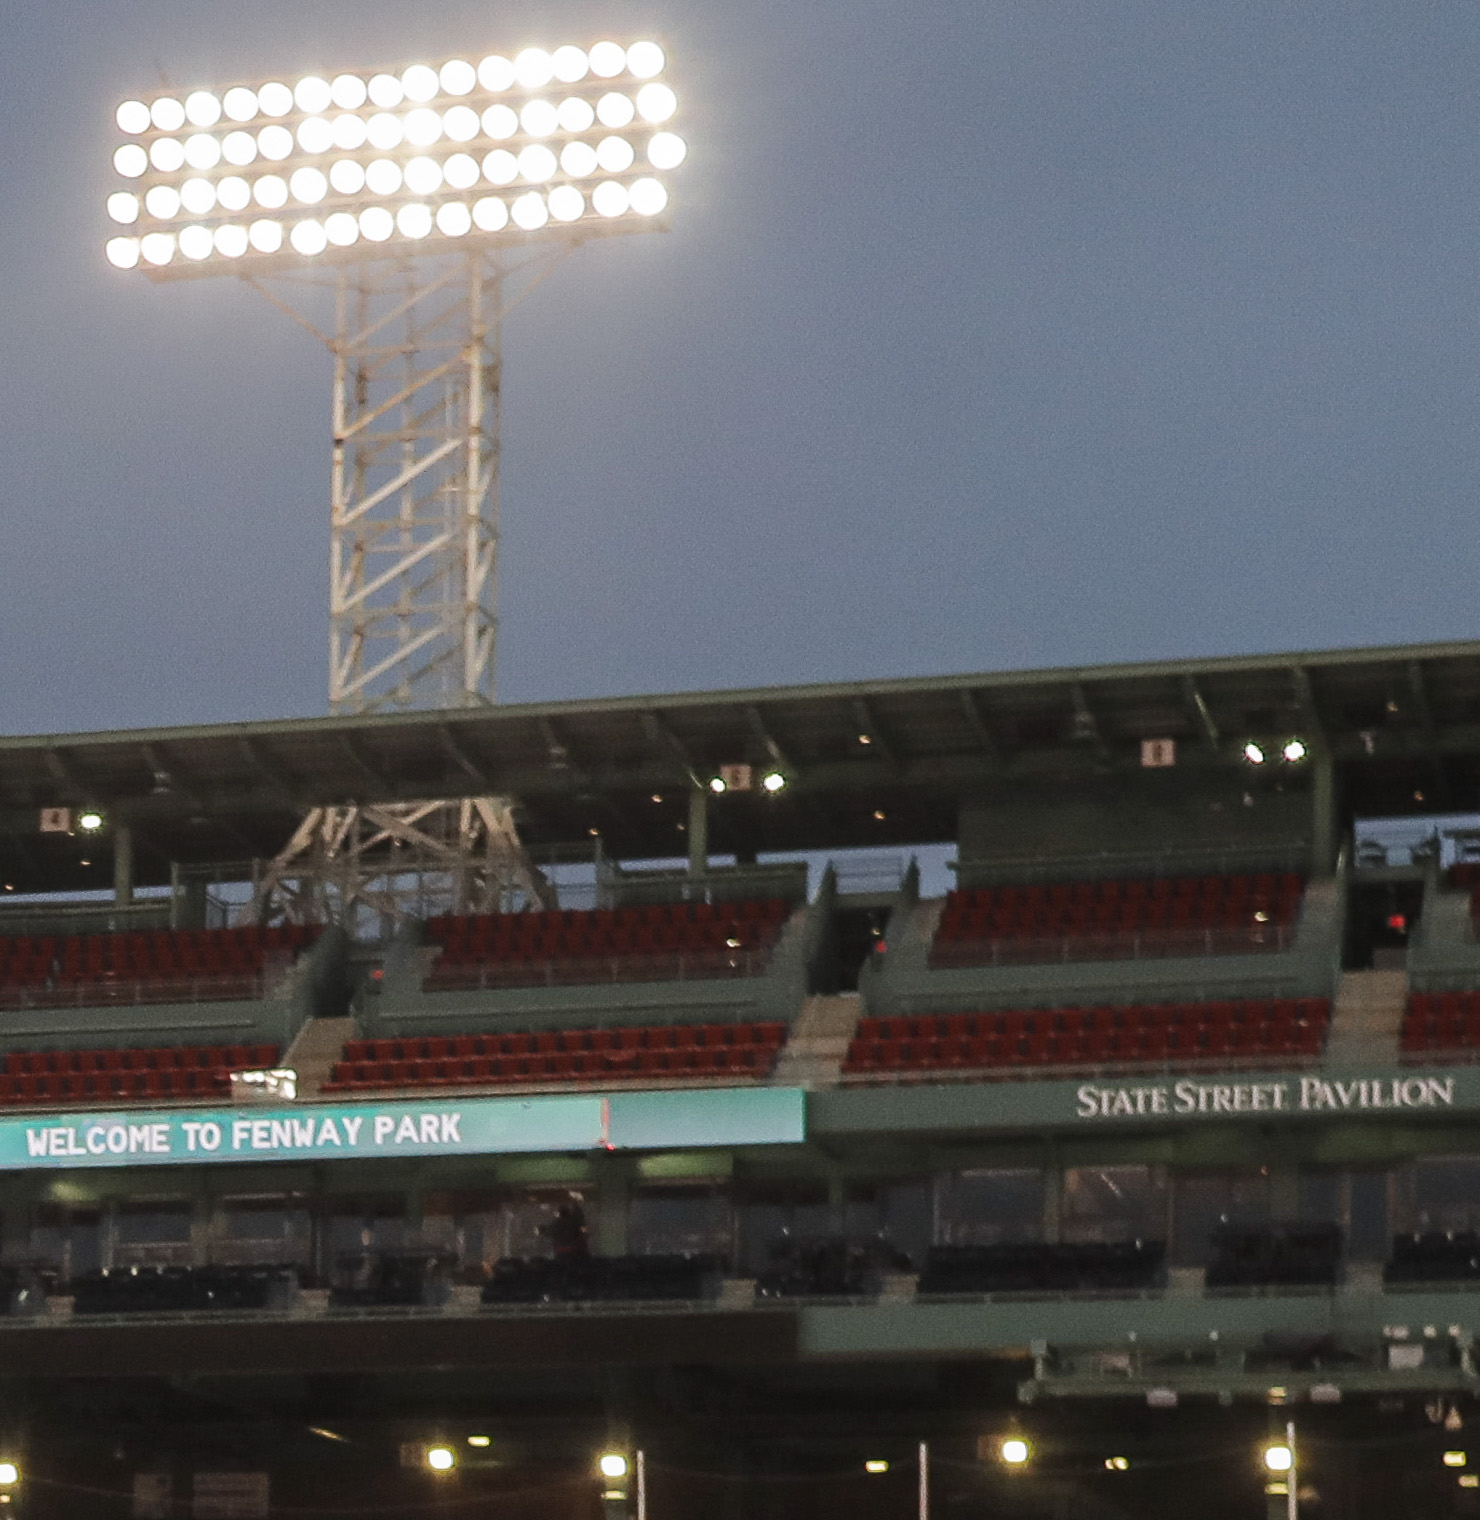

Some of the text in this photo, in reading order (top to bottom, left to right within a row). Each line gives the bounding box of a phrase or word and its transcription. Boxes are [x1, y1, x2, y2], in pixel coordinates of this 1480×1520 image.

[1076, 1075, 1454, 1118] STATE STREET PAVILION
[25, 1112, 462, 1157] WELCOME TO FENWAY PARK
